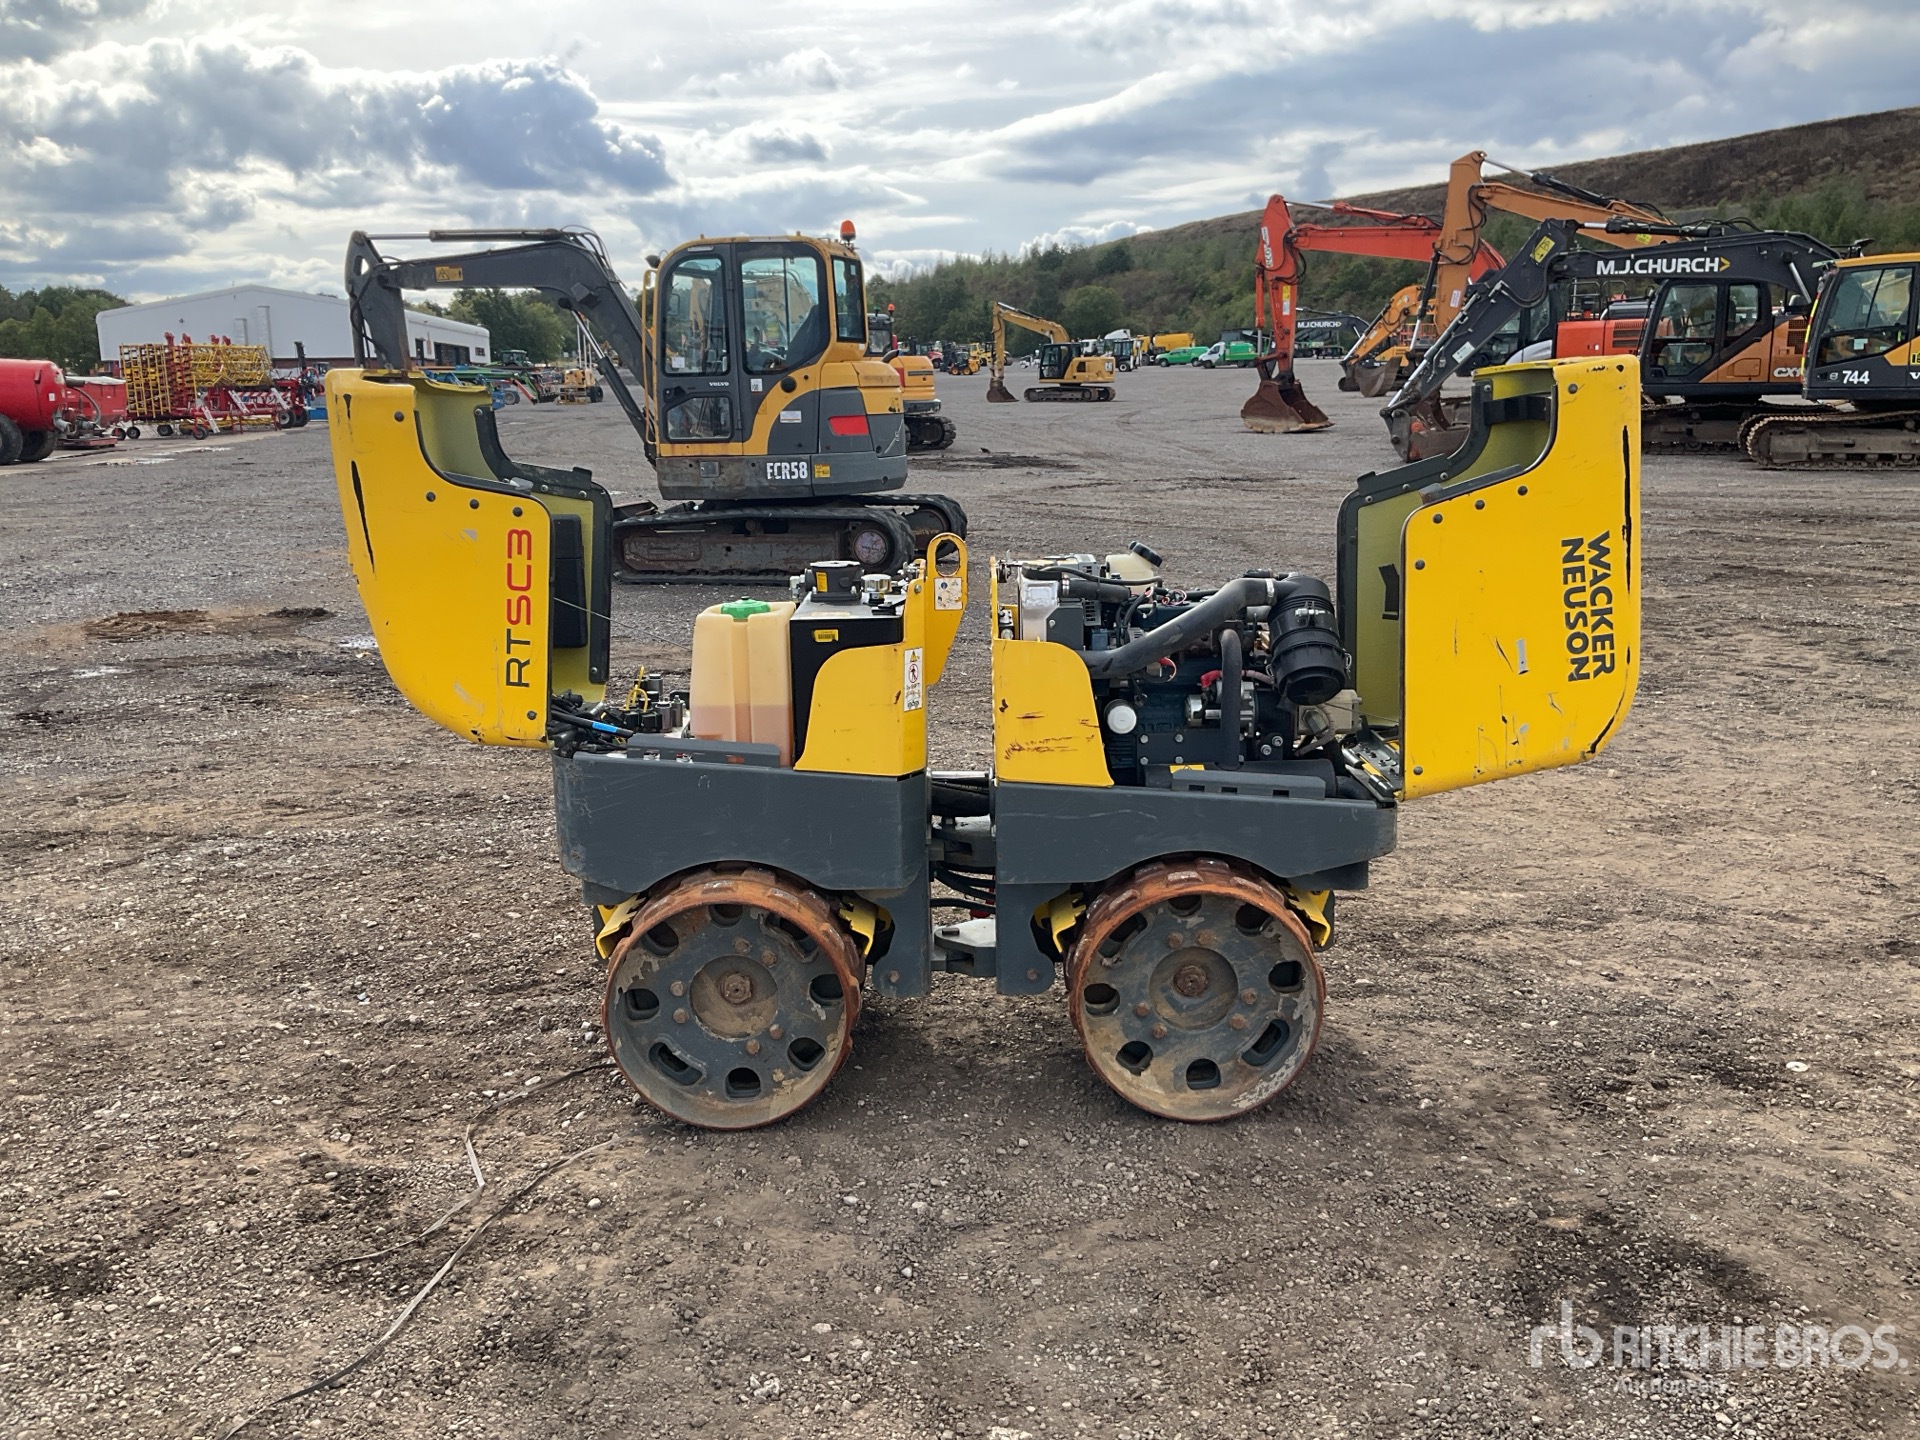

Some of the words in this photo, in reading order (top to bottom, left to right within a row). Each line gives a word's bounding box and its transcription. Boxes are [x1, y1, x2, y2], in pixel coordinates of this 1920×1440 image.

[1842, 370, 1870, 384] 744
[766, 461, 808, 480] ECR58
[1561, 537, 1590, 682] NEUSON
[1587, 530, 1615, 679] WACKER
